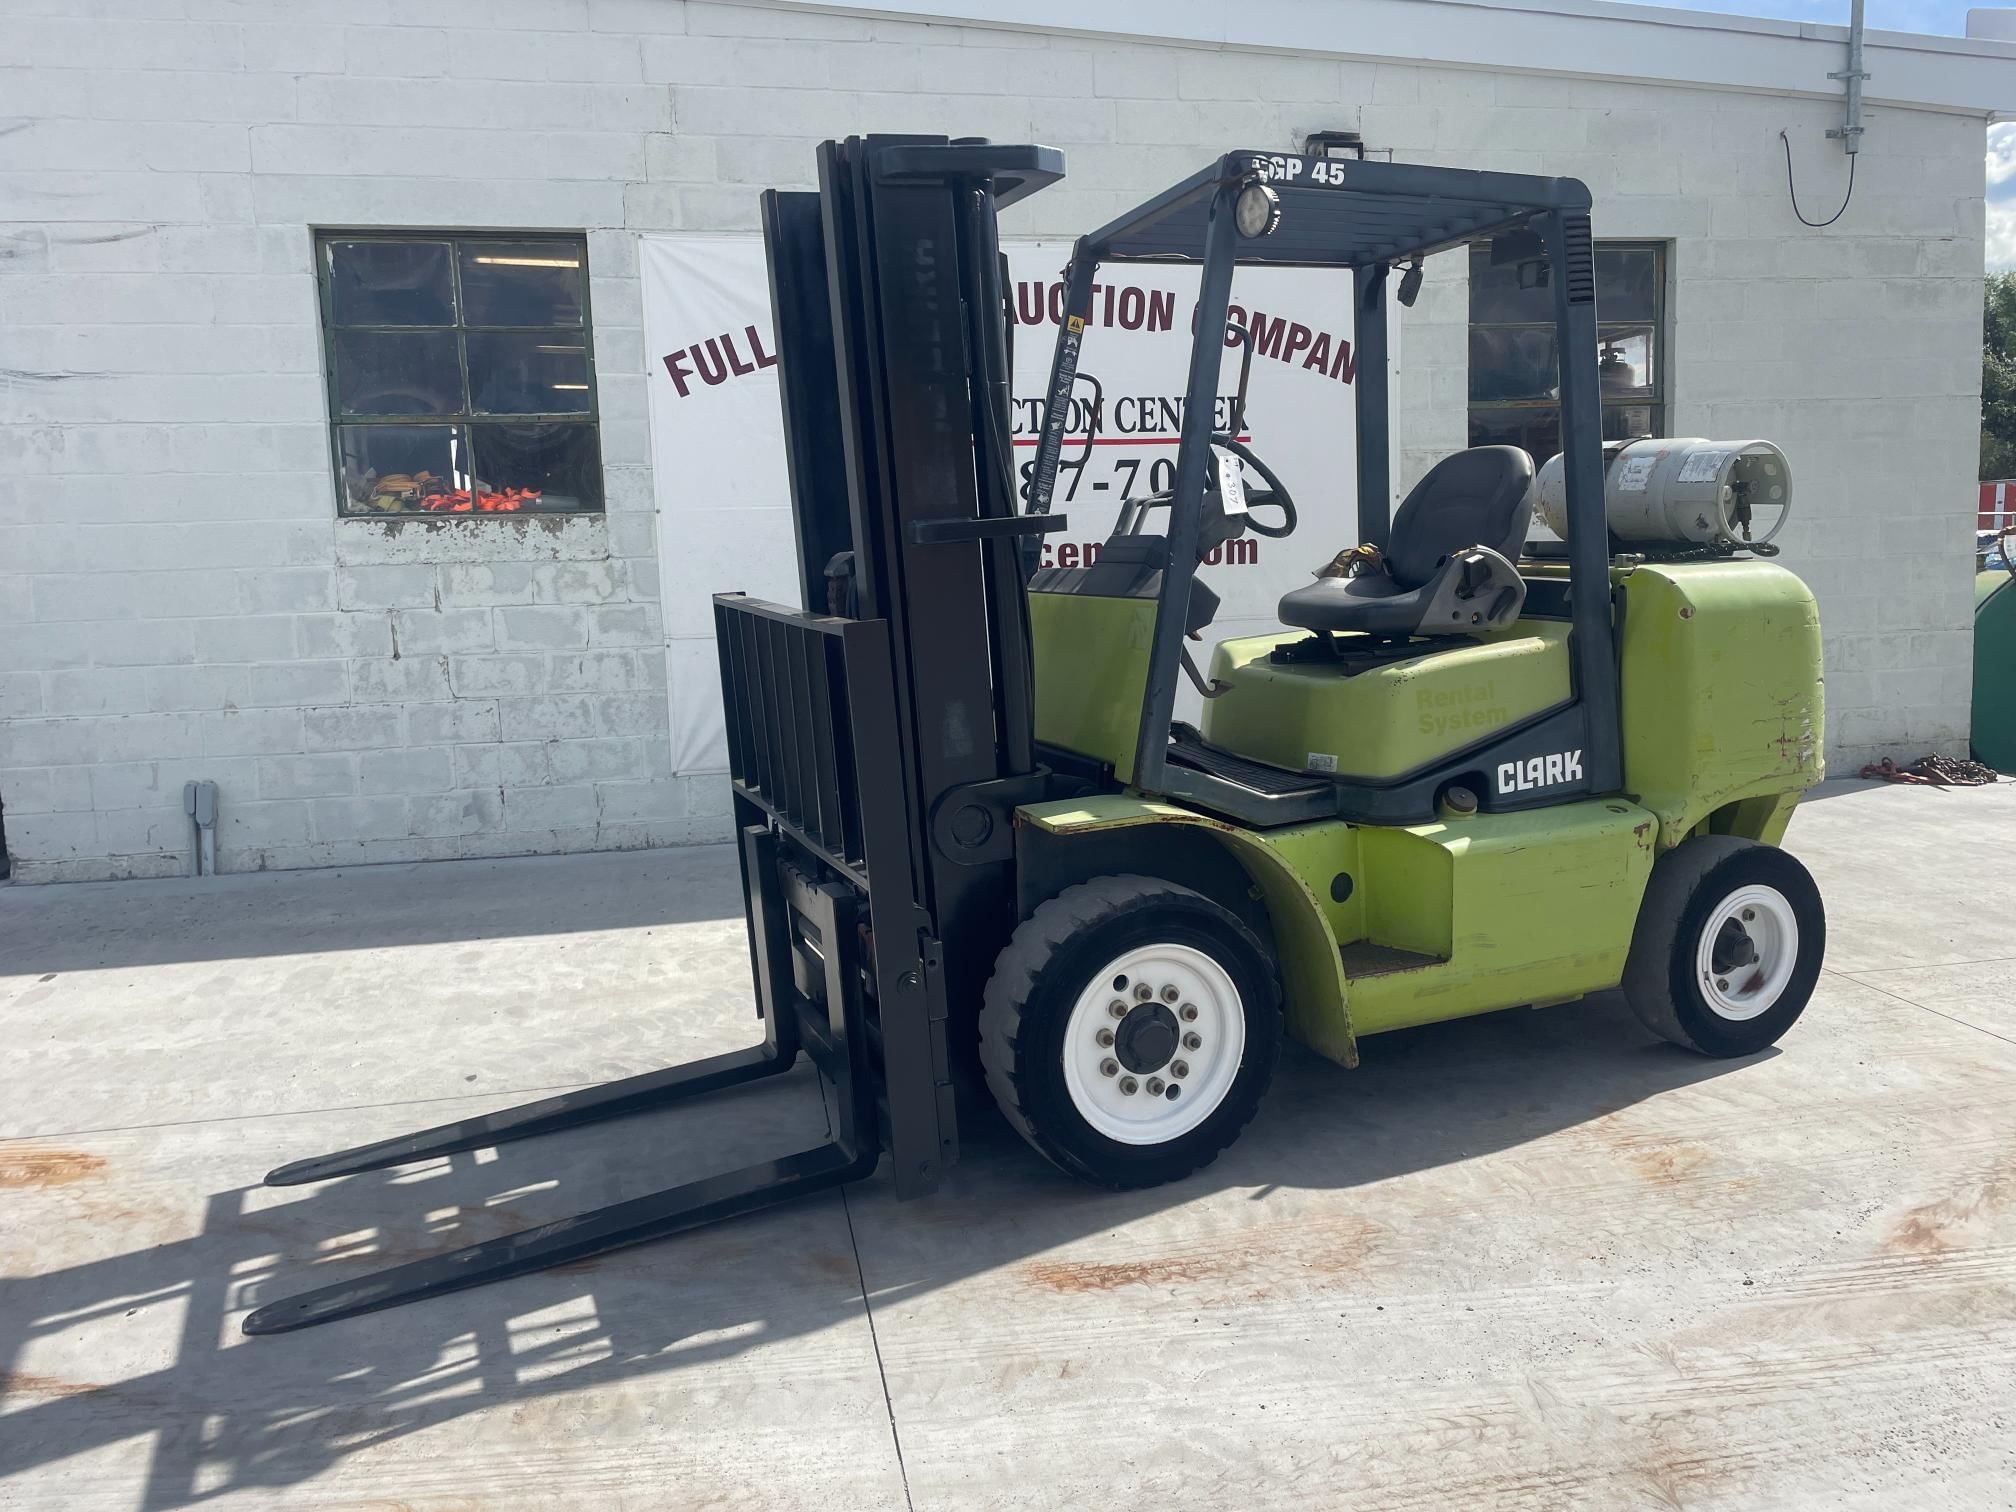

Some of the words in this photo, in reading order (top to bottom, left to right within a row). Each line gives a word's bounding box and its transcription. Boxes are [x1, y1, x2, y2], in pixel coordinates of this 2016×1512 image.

[1311, 161, 1345, 185] 45
[1191, 301, 1356, 386] OMPAN
[1415, 680, 1496, 710] Rental
[1417, 706, 1507, 736] System
[1497, 750, 1583, 794] CLARK
